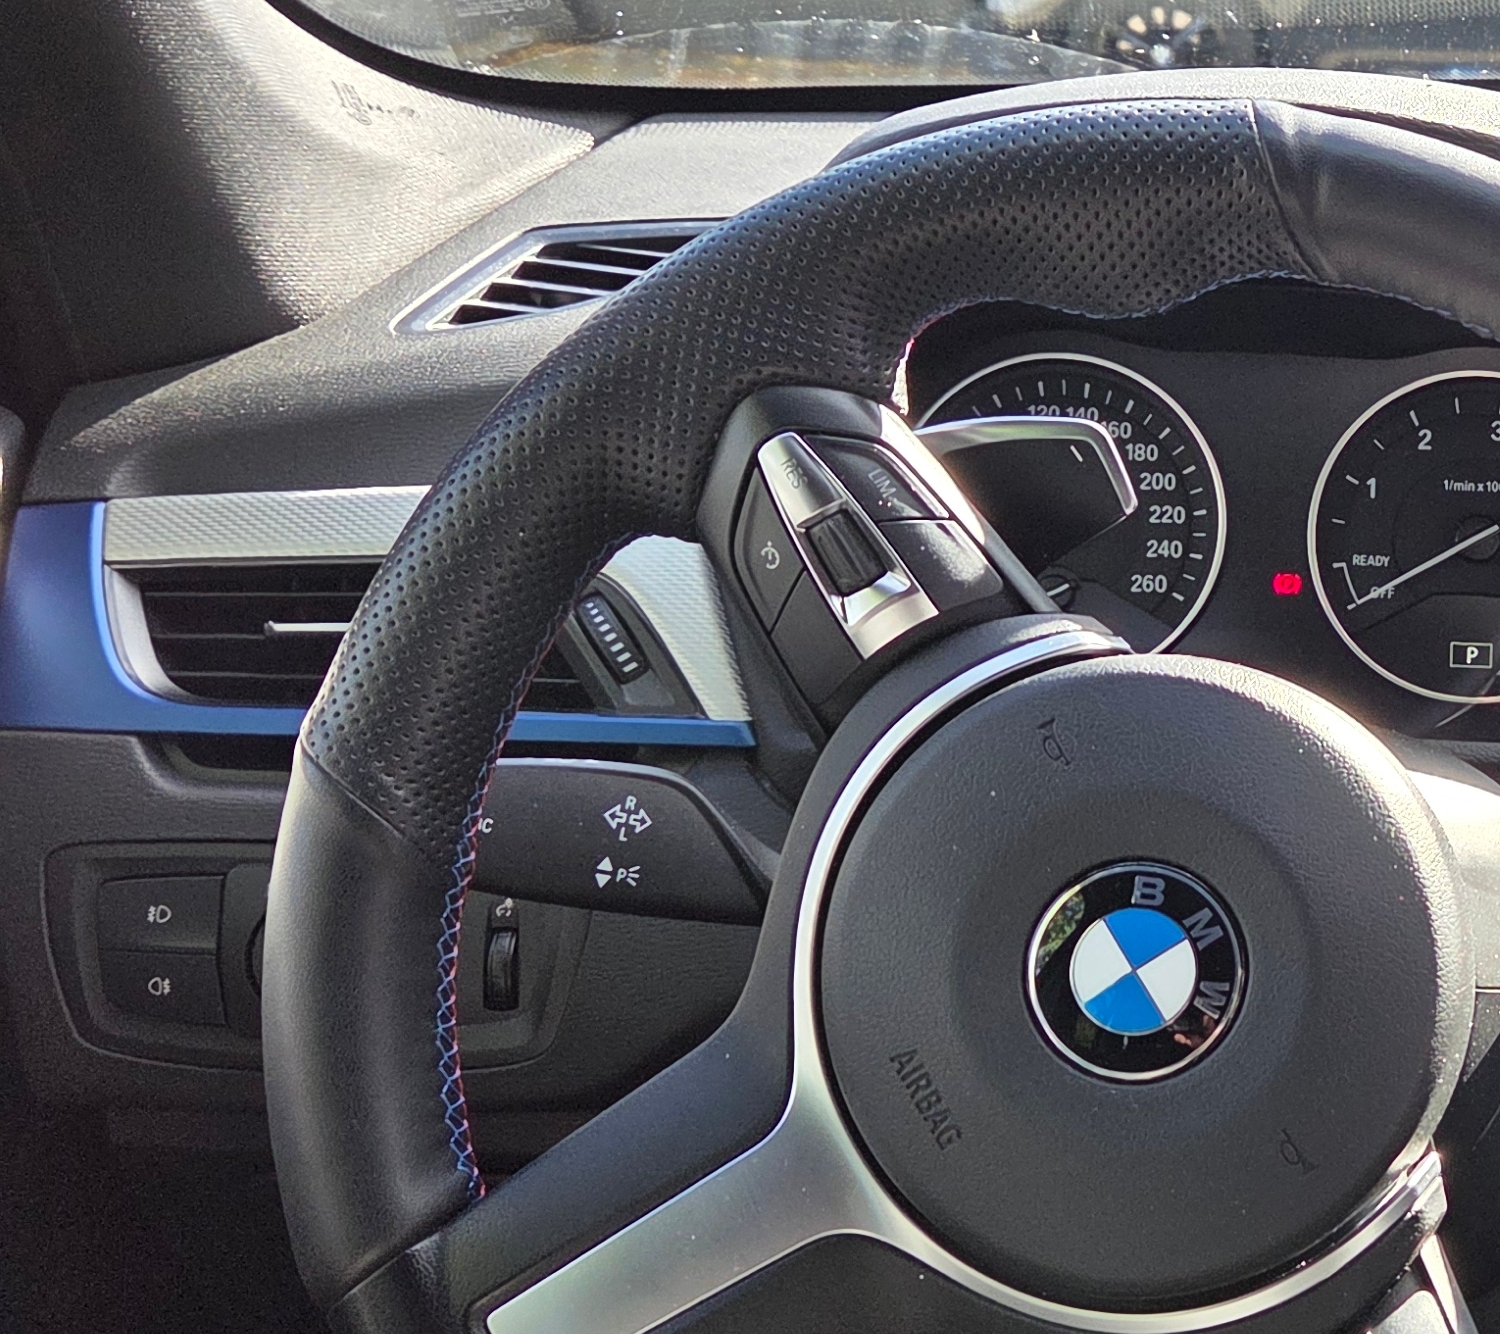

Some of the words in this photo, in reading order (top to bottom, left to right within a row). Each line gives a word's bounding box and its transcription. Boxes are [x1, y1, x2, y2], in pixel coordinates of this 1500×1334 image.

[1066, 406, 1099, 421] 140
[1101, 420, 1132, 439] 60
[1417, 429, 1432, 450] 2
[1125, 443, 1159, 462] 180
[781, 456, 808, 490] RES
[1139, 472, 1177, 491] 200
[868, 469, 894, 498] LIM
[1366, 477, 1377, 499] 1
[1443, 479, 1475, 493] 1/min
[1477, 483, 1485, 493] x
[1149, 505, 1186, 524] 220
[1146, 539, 1183, 559] 240
[1352, 554, 1390, 567] READY
[1130, 574, 1168, 593] 260
[1370, 586, 1395, 600] OFF
[1466, 646, 1479, 664] P
[625, 795, 637, 811] R
[618, 826, 628, 842] L
[1131, 875, 1230, 1019] BMW
[889, 1047, 963, 1151] AIRBAG
